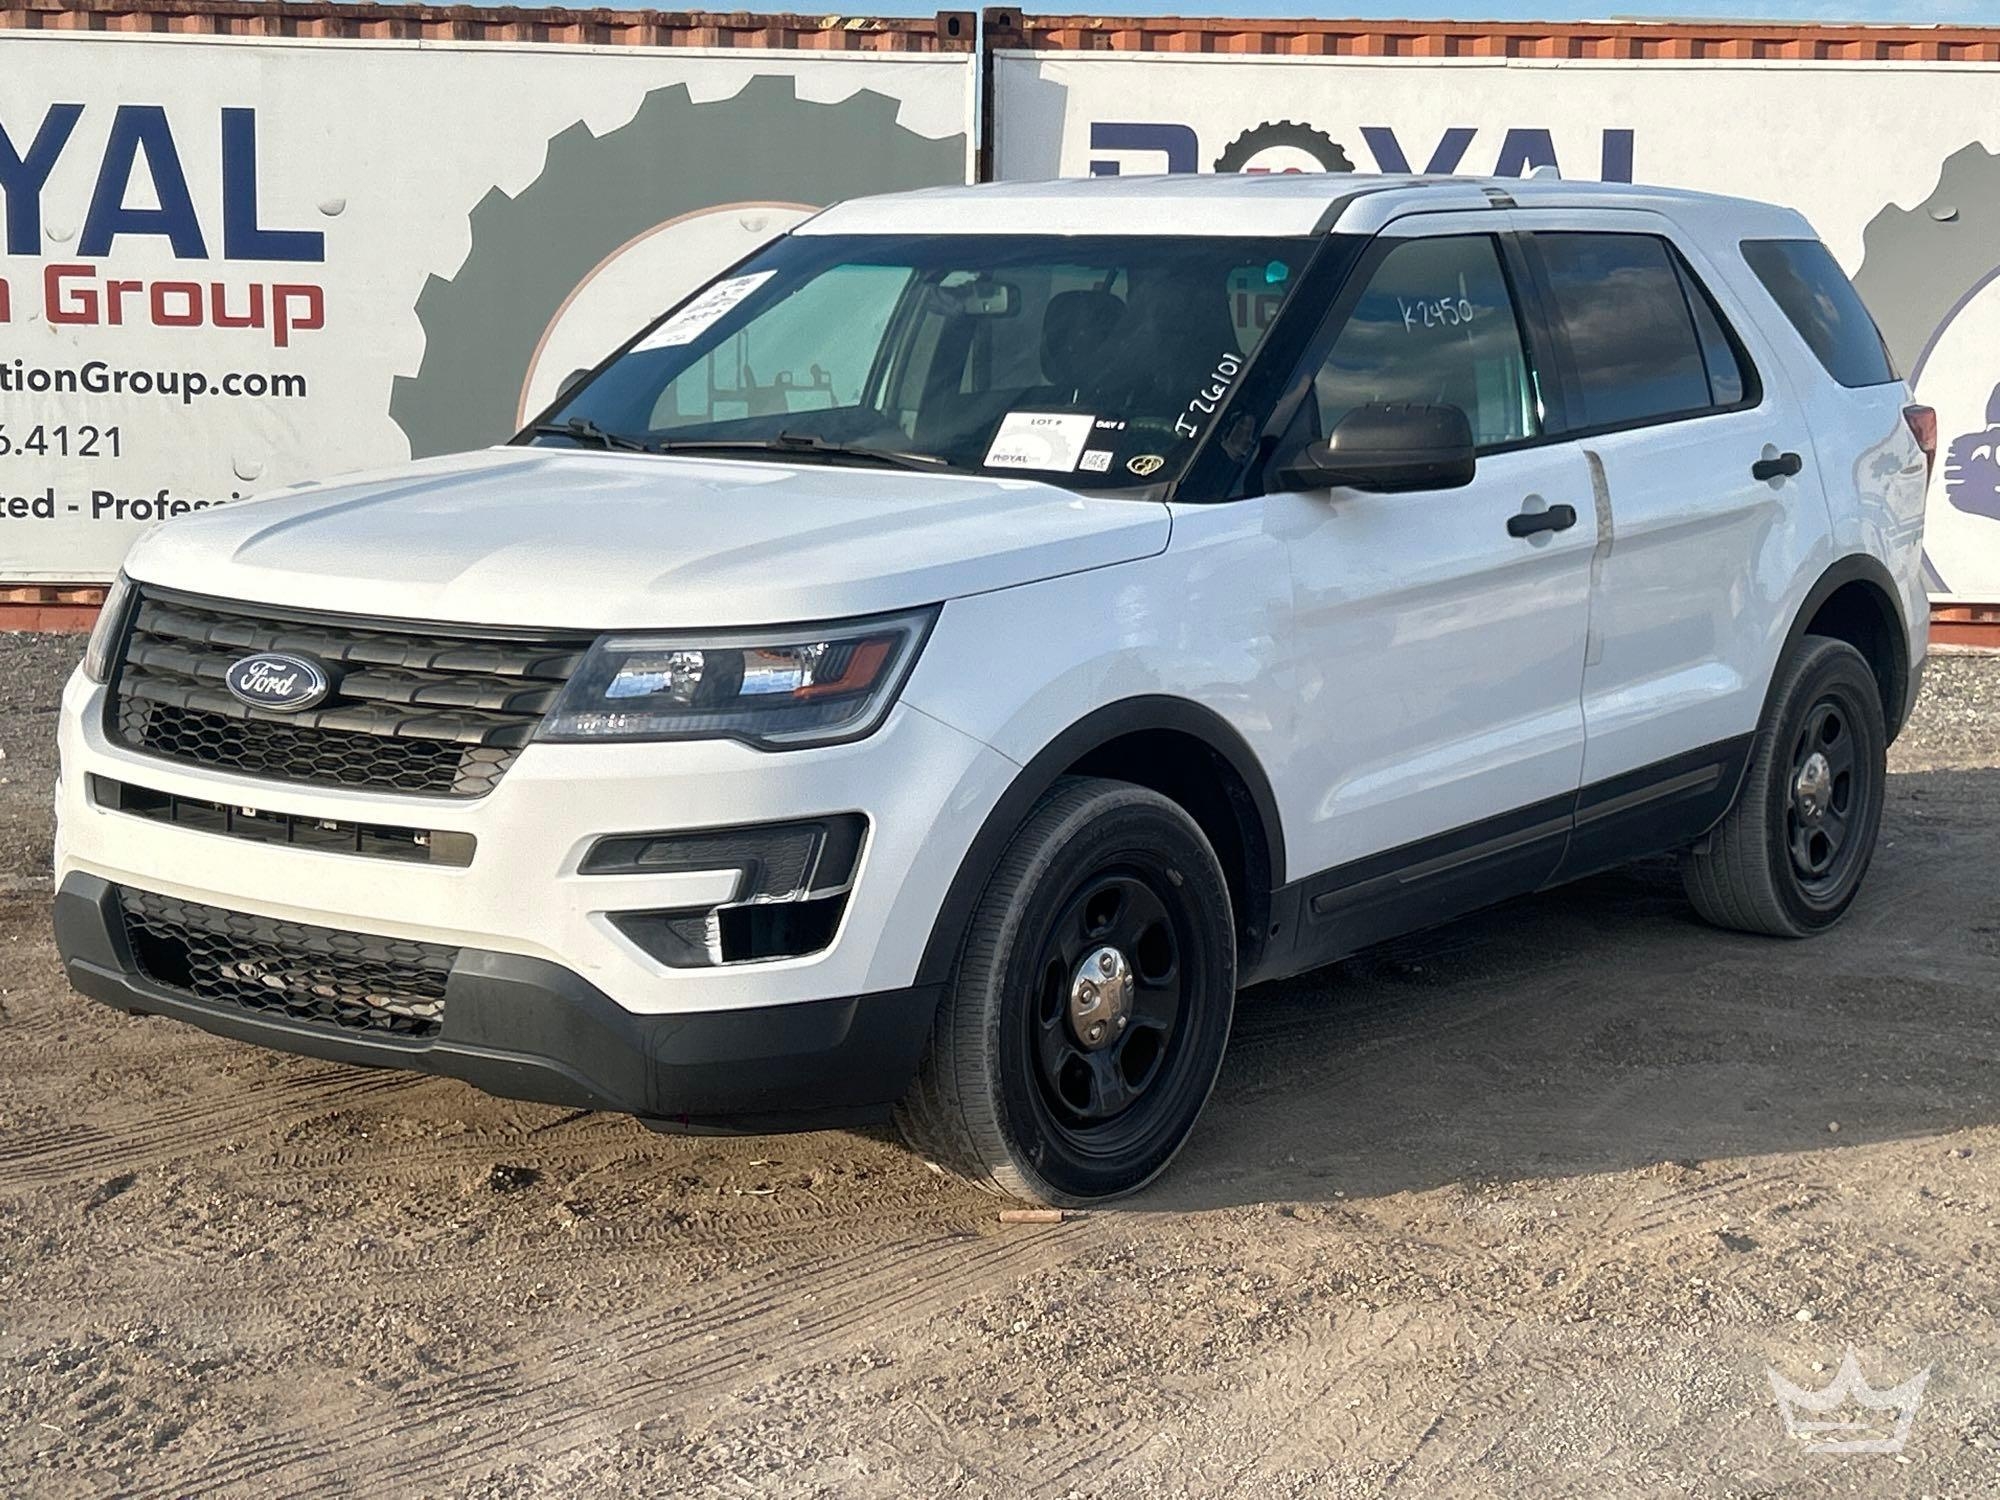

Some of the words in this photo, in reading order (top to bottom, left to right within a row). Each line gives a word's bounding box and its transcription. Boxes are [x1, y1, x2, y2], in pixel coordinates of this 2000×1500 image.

[0, 103, 325, 263] YAL
[44, 264, 325, 347] Group
[1031, 418, 1053, 426] LOT
[240, 660, 298, 696] Ford
